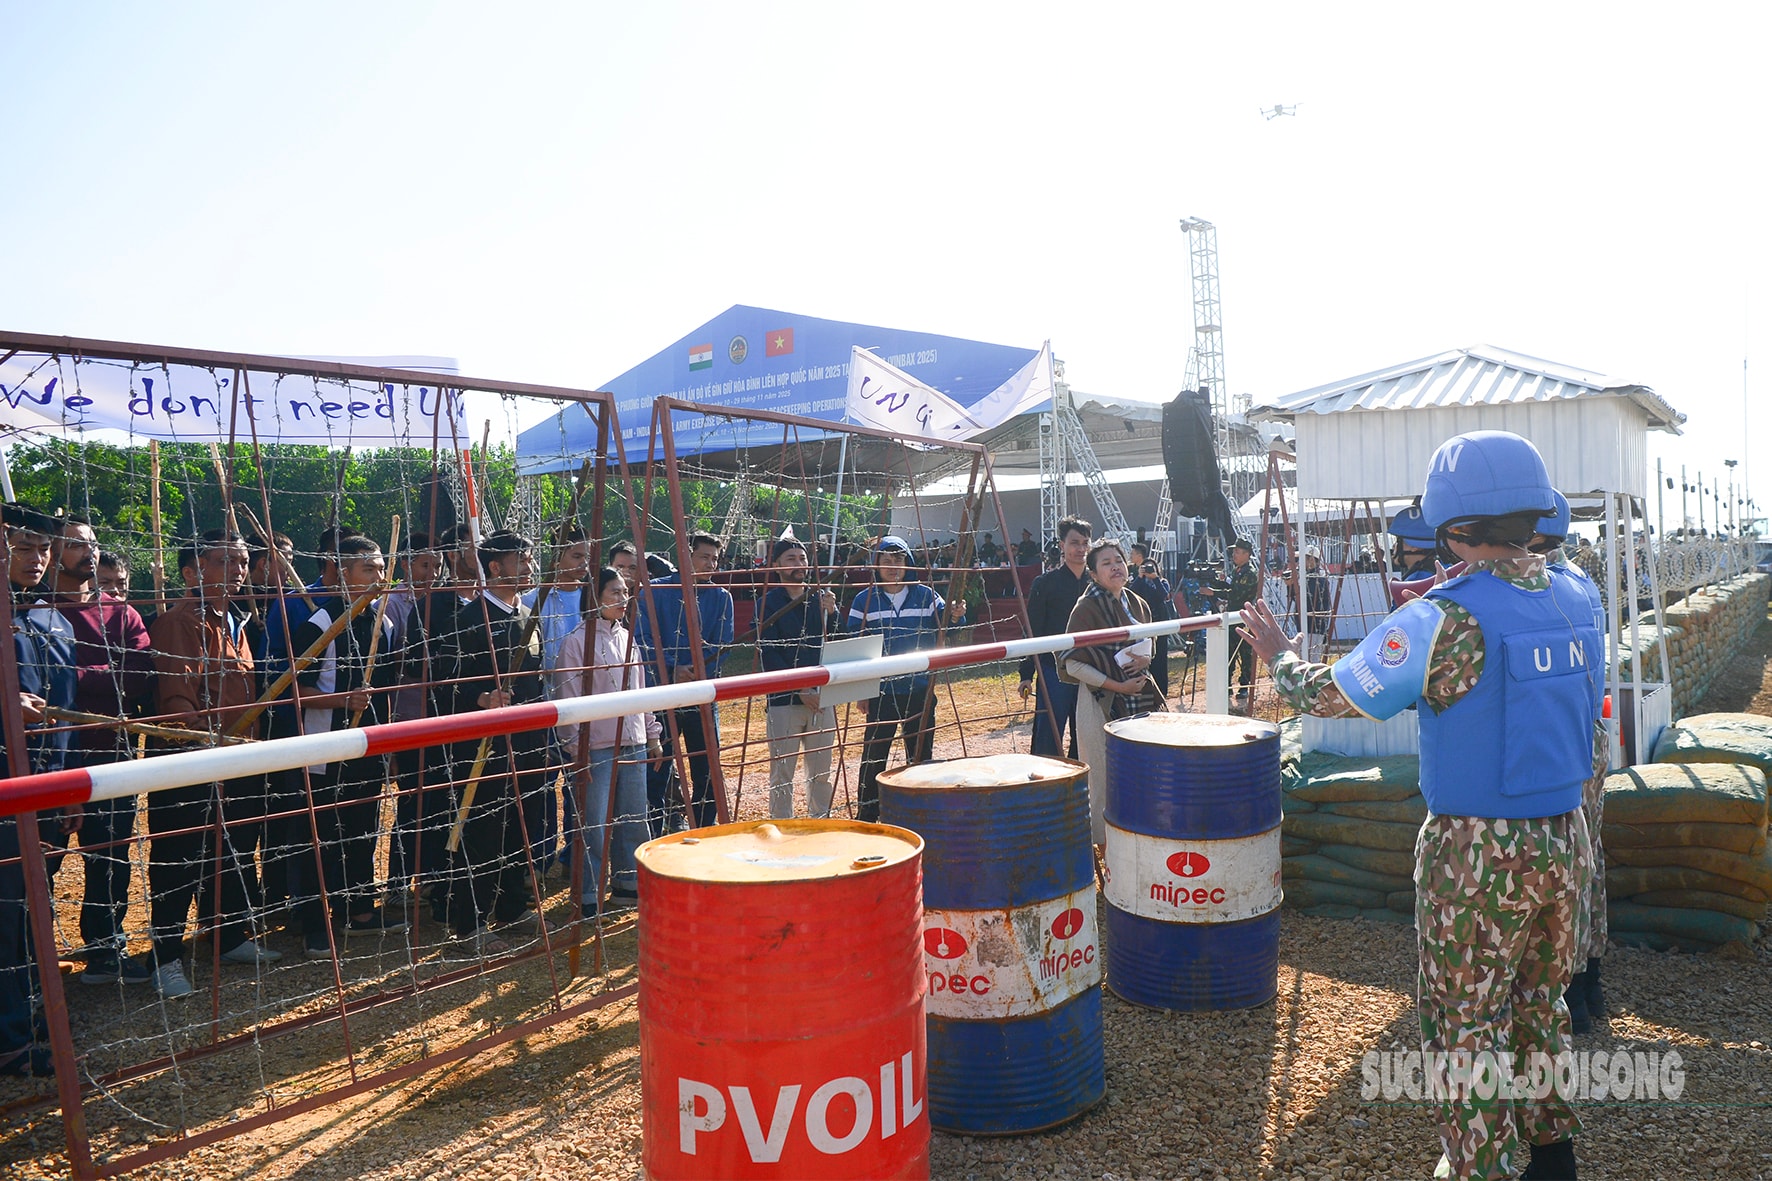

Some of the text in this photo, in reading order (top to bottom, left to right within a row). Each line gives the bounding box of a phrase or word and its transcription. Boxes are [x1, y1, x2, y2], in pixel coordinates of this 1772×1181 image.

[746, 376, 761, 390] BÌNH
[762, 373, 776, 388] LIÊN
[776, 371, 789, 388] HỢP
[790, 366, 806, 385] QUỐC
[808, 366, 824, 381] NĂM
[825, 364, 840, 378] 2025
[917, 349, 937, 365] 2025)
[0, 377, 94, 411] We
[128, 377, 264, 421] don't
[291, 384, 396, 422] need
[778, 389, 791, 398] 2025
[676, 420, 690, 432] ARMY
[1350, 651, 1385, 698] RAINEE
[1150, 881, 1226, 908] mipec
[924, 963, 991, 996] ipec
[1039, 944, 1095, 981] mipec
[678, 1050, 923, 1163] PVOIL
